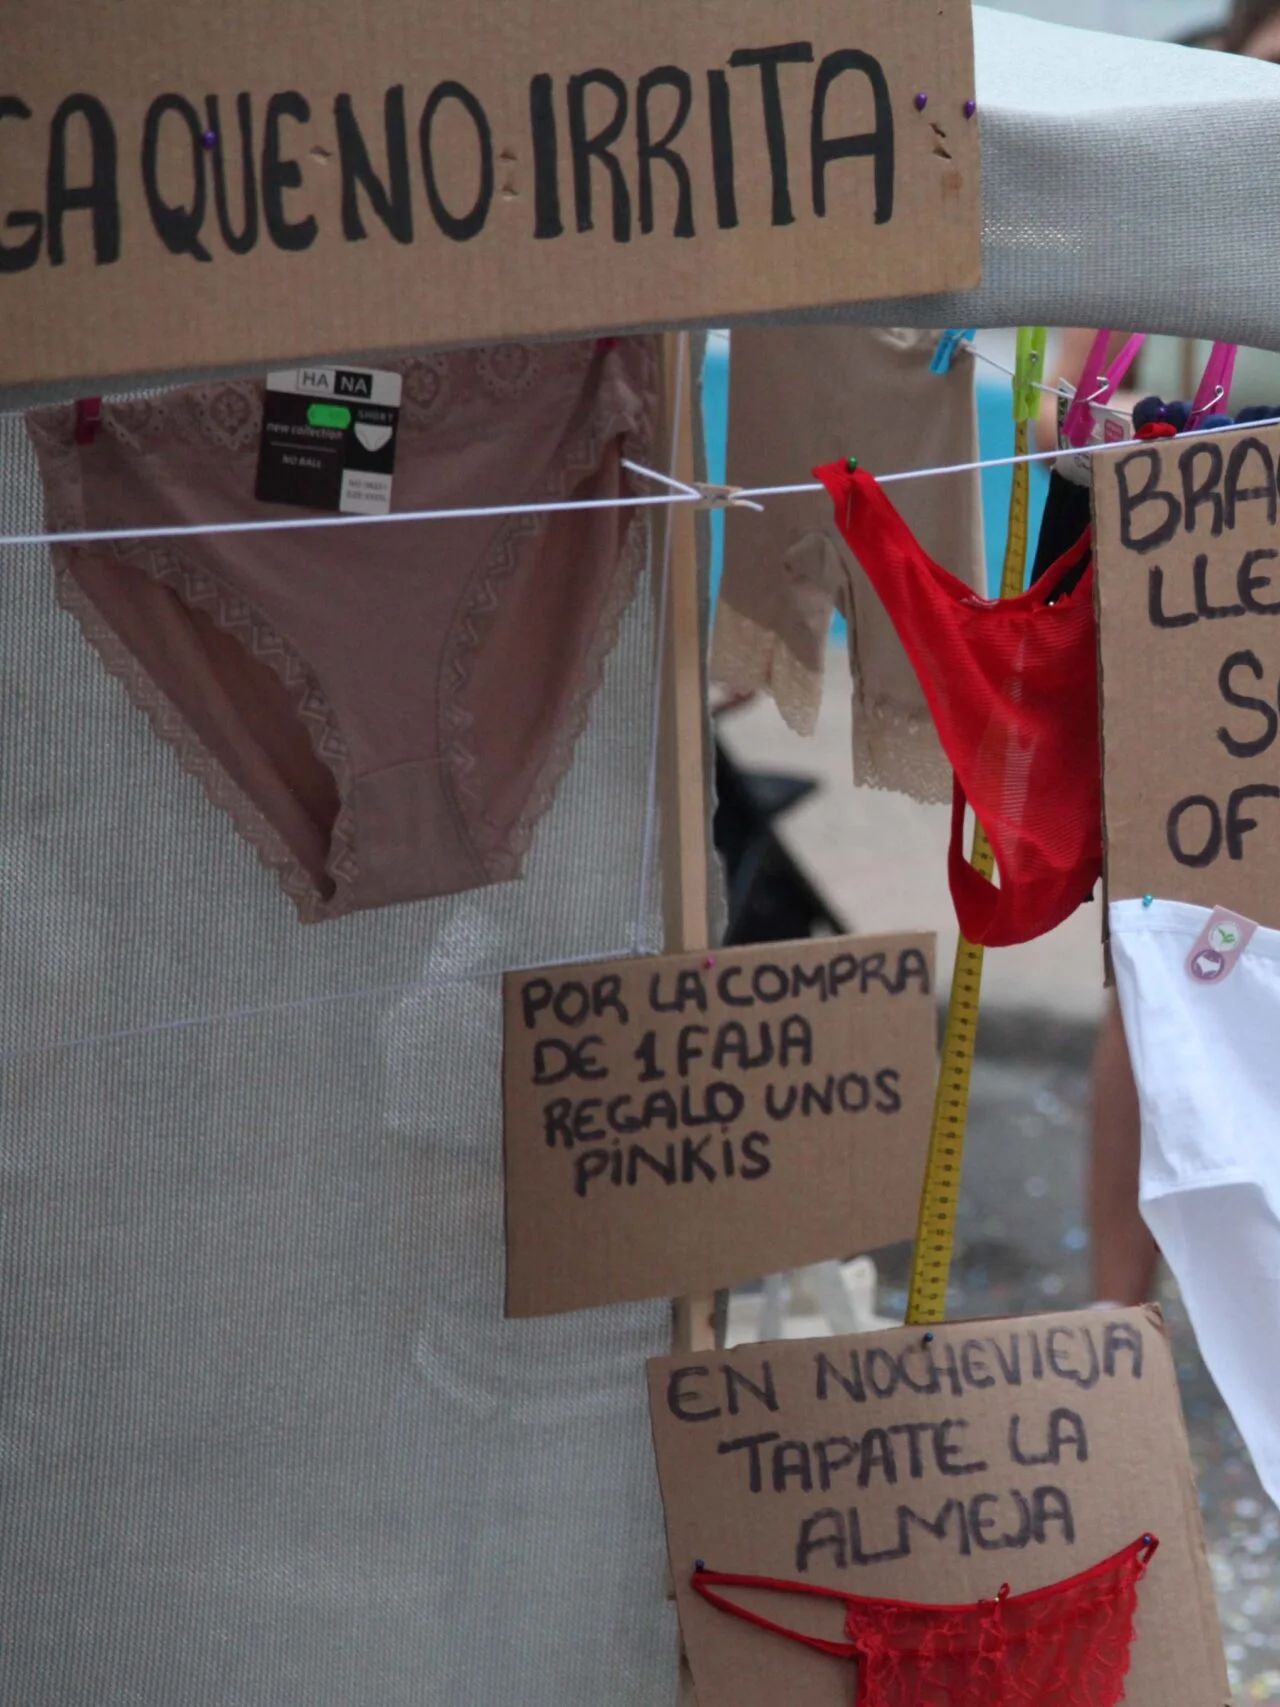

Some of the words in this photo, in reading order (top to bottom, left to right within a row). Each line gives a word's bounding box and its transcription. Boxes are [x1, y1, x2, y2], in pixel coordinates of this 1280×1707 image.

[141, 90, 320, 262] QUE
[334, 79, 494, 244] NO
[531, 41, 895, 243] IRRITA
[302, 371, 329, 388] HA
[340, 376, 368, 394] NA
[521, 974, 630, 1029] POR
[648, 970, 707, 1014] LA
[717, 948, 931, 1007] COMPRA
[532, 1035, 608, 1085] DE
[634, 1030, 665, 1082] 1
[677, 1014, 813, 1076] FAJA
[543, 1082, 744, 1149] REGALO
[765, 1068, 902, 1120] UNOS
[667, 1360, 780, 1422] EN
[815, 1322, 1144, 1402] NOCHEVIEJA
[717, 1418, 987, 1494] TAPATE
[1009, 1407, 1088, 1466] LA
[795, 1485, 1076, 1572] ALMEJA
